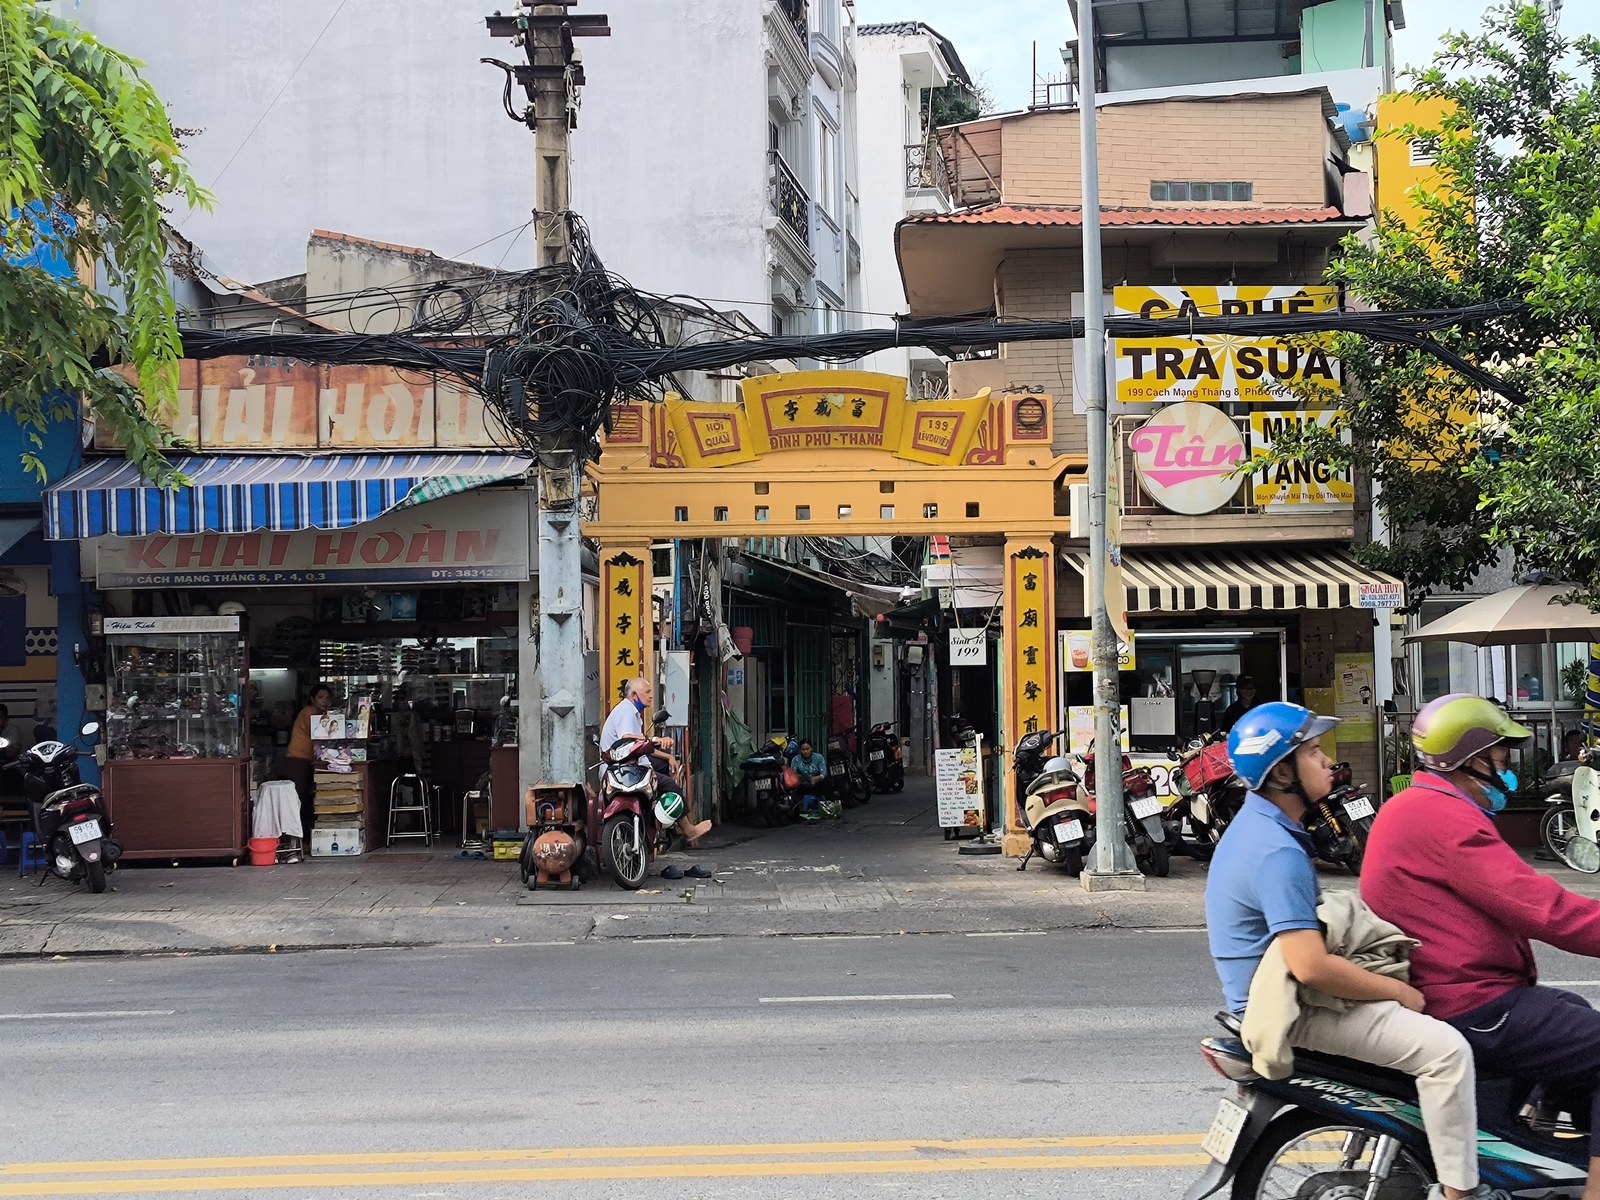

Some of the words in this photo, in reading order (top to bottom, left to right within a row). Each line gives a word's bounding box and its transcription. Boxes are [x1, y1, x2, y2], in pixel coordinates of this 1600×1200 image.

[1122, 339, 1220, 379] TRÀ
[1127, 388, 1144, 396] 199
[1146, 387, 1170, 397] Cách
[1173, 388, 1199, 398] Mạng
[1201, 387, 1231, 398] Tháng
[929, 420, 949, 431] 199
[1131, 424, 1244, 467] Tân
[313, 524, 501, 566] HOÀN
[137, 574, 170, 584] CÁCH
[174, 575, 210, 585] MẠNG
[213, 572, 254, 582] THÁNG
[1370, 584, 1382, 593] GIA
[1384, 584, 1399, 593] HUY
[956, 647, 979, 657] 199
[1320, 1094, 1350, 1105] 100
